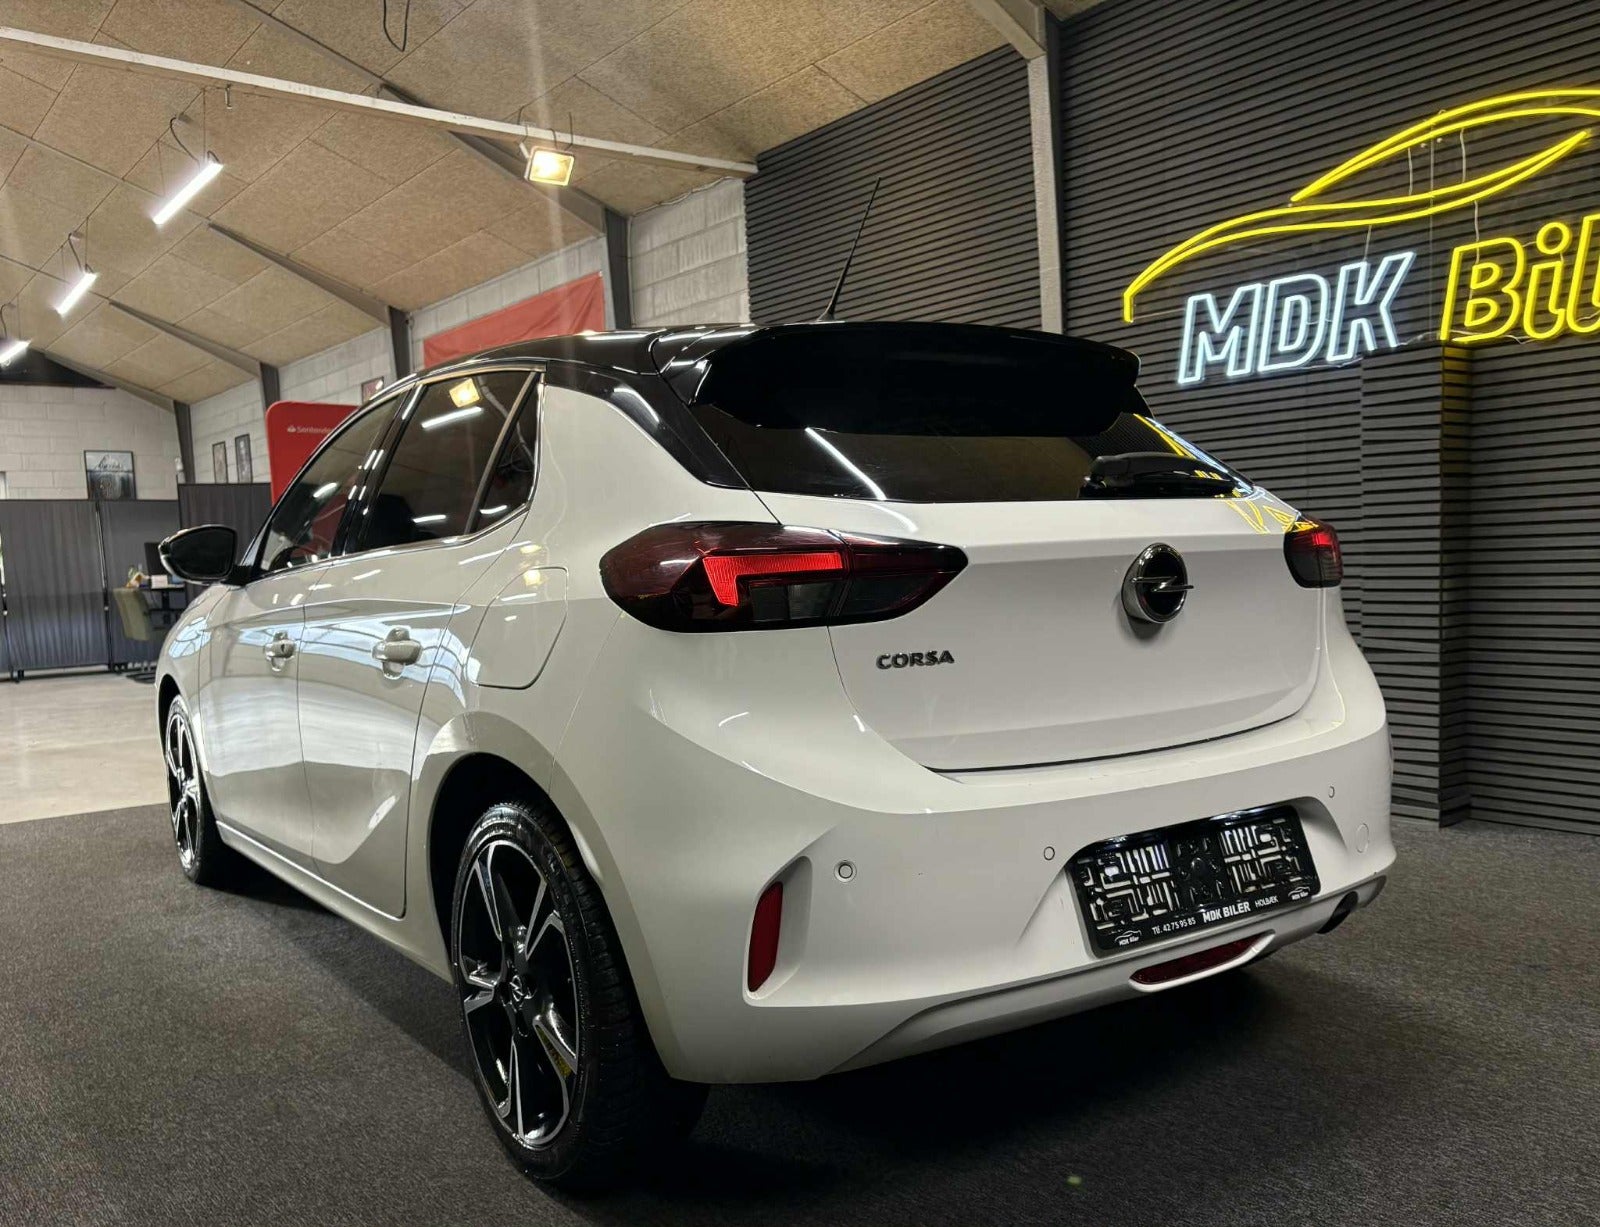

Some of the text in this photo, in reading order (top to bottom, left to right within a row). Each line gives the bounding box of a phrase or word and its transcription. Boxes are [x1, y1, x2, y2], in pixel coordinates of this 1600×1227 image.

[1178, 250, 1416, 385] MDK
[876, 650, 955, 670] CORSA
[1163, 923, 1171, 932] 42
[1171, 921, 1180, 931] 75
[1179, 919, 1188, 928] 95
[1202, 910, 1223, 923] MDK
[1222, 901, 1252, 918] BILER
